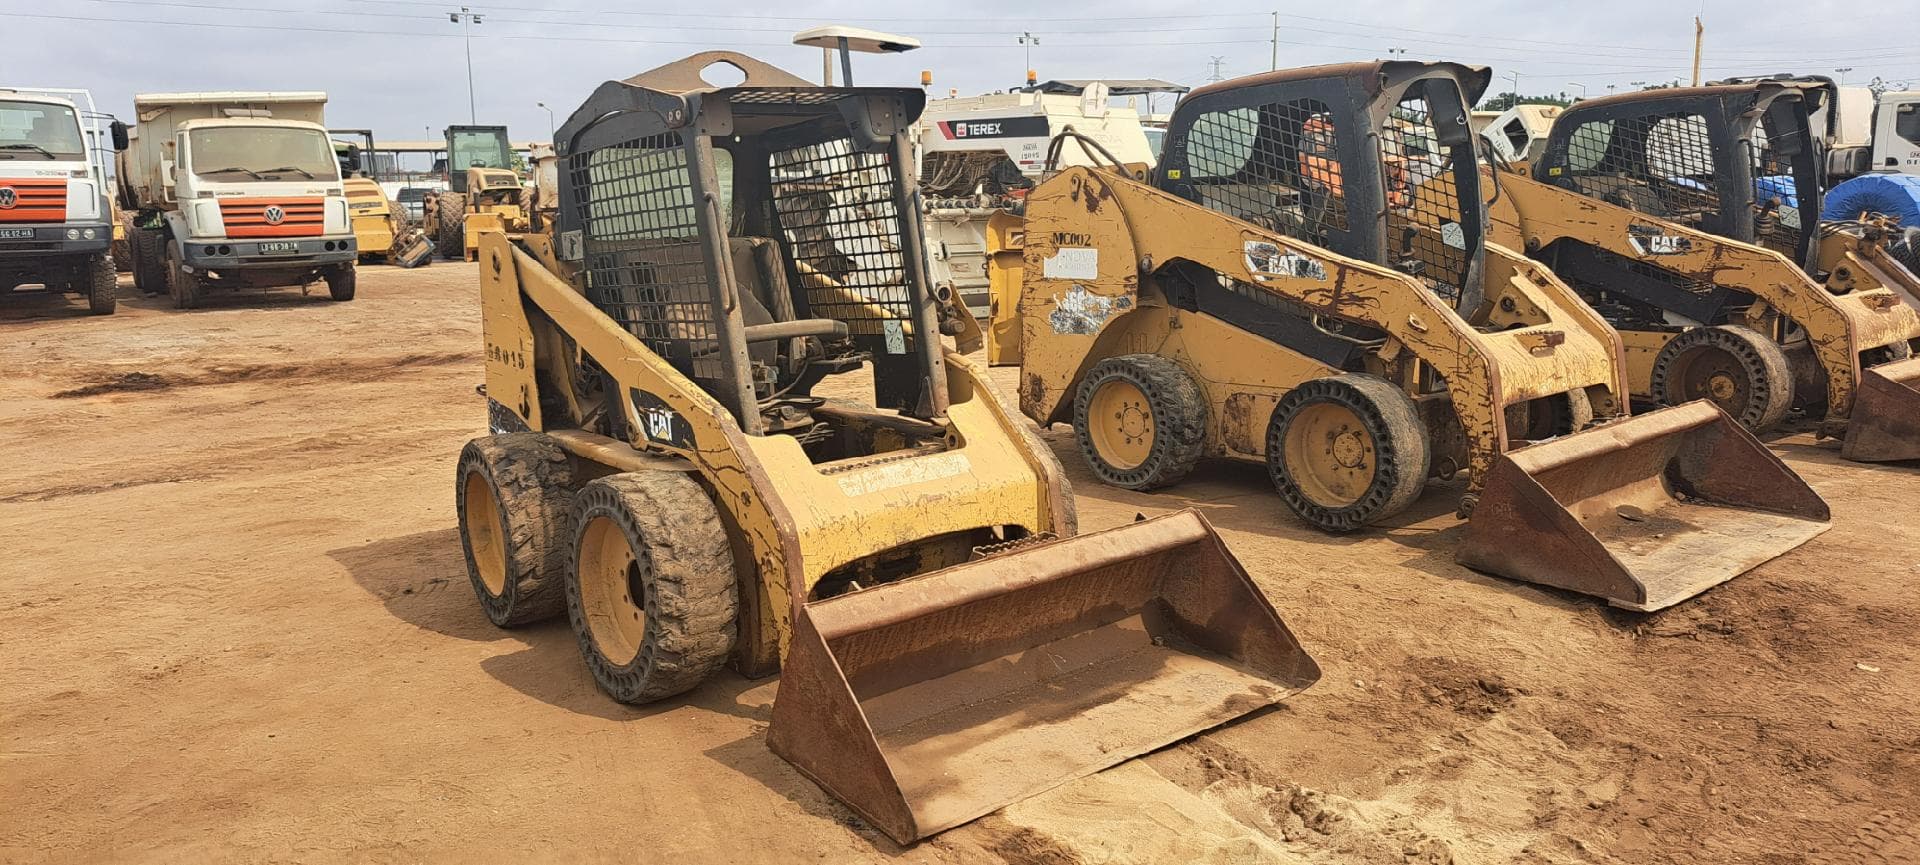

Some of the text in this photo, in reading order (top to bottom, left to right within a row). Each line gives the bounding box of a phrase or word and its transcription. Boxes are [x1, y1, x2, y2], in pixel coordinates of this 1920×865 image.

[968, 123, 1001, 135] TEREX
[1052, 232, 1091, 247] MC002
[649, 407, 673, 441] CAT
